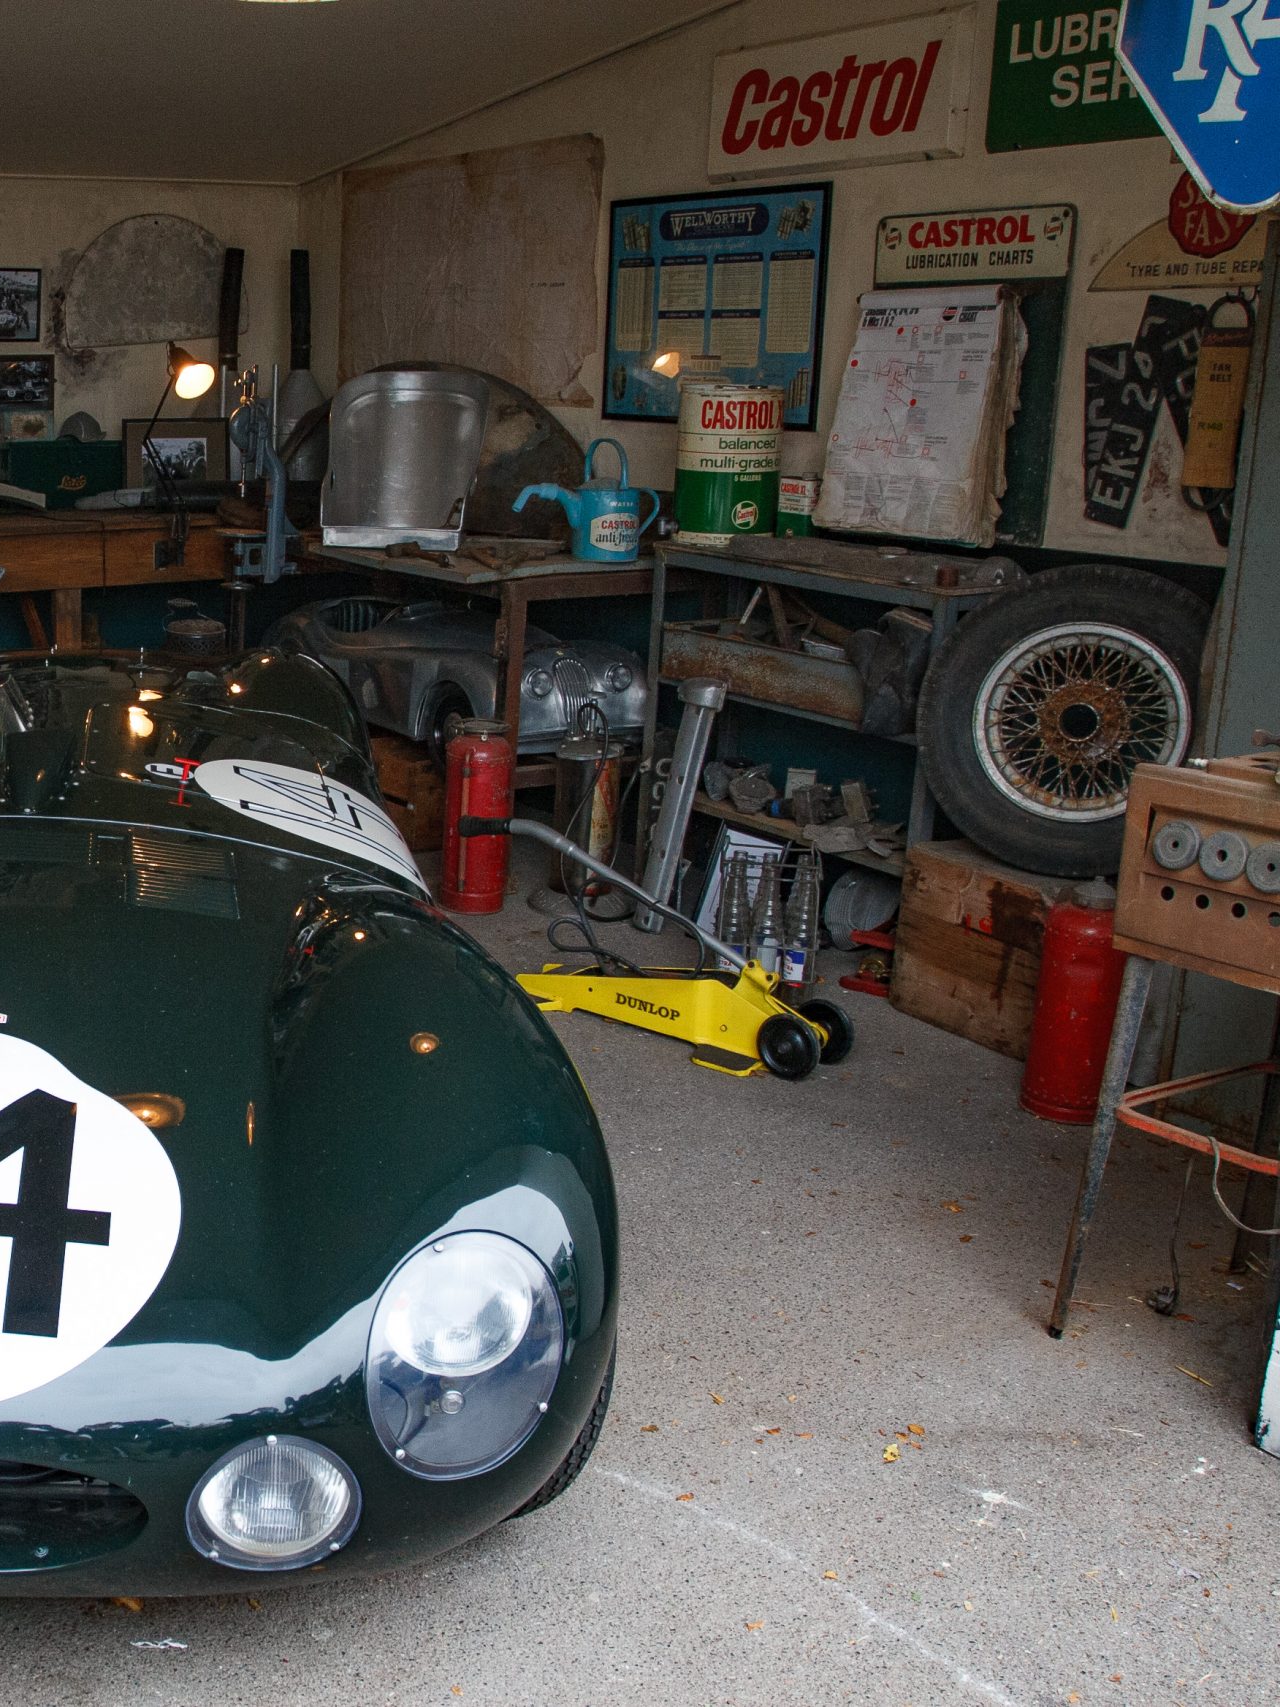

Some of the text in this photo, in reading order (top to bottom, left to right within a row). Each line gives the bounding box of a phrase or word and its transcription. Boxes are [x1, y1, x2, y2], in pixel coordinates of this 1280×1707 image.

[721, 39, 943, 155] Castrol
[670, 207, 756, 237] WELLWORTHY
[908, 214, 1035, 249] CASTROL
[1184, 207, 1244, 247] FAS
[906, 249, 1034, 270] LUBRICATION CHARTS
[1165, 263, 1189, 276] AND
[1195, 261, 1227, 275] TUBE
[1209, 374, 1232, 382] BELT
[701, 400, 774, 430] CASTROL
[718, 437, 776, 450] balanced
[700, 456, 773, 472] multi-grade
[615, 992, 680, 1021] DUNLOP
